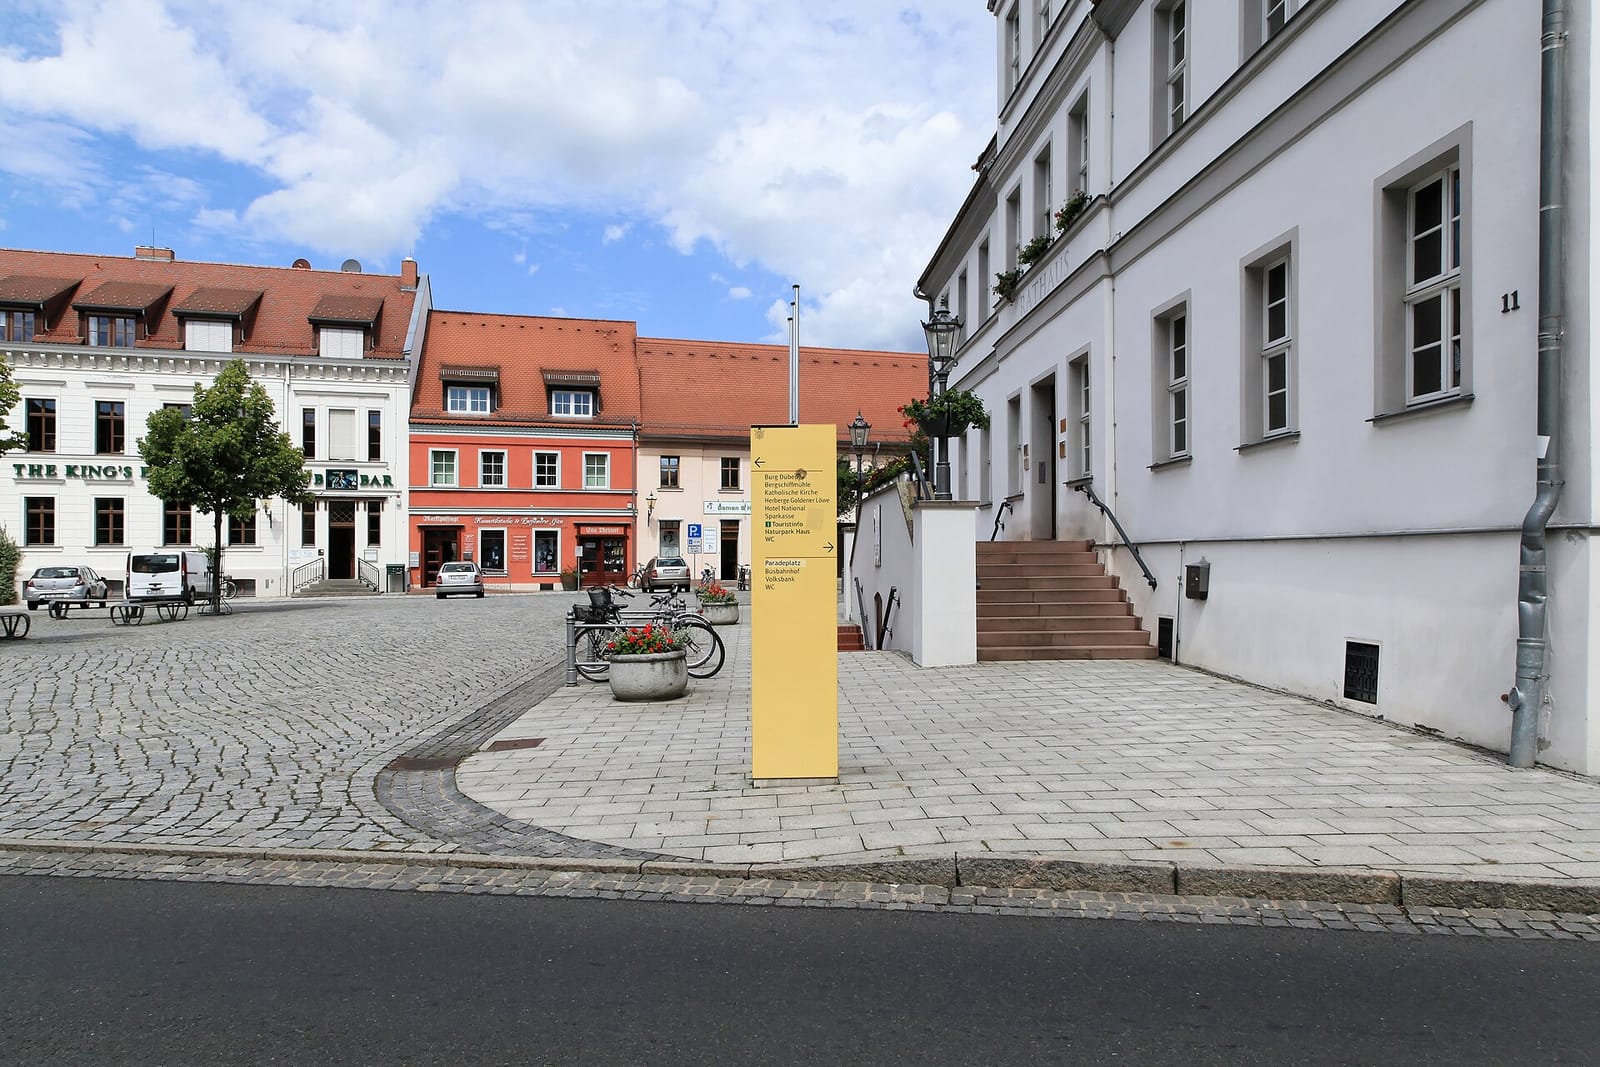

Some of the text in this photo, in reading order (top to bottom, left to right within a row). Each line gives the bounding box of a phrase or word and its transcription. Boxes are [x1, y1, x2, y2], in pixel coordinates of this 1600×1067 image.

[1501, 290, 1520, 313] 11
[13, 463, 57, 478] THE
[65, 464, 133, 479] KING'S
[360, 474, 393, 487] BAR
[689, 525, 698, 537] P
